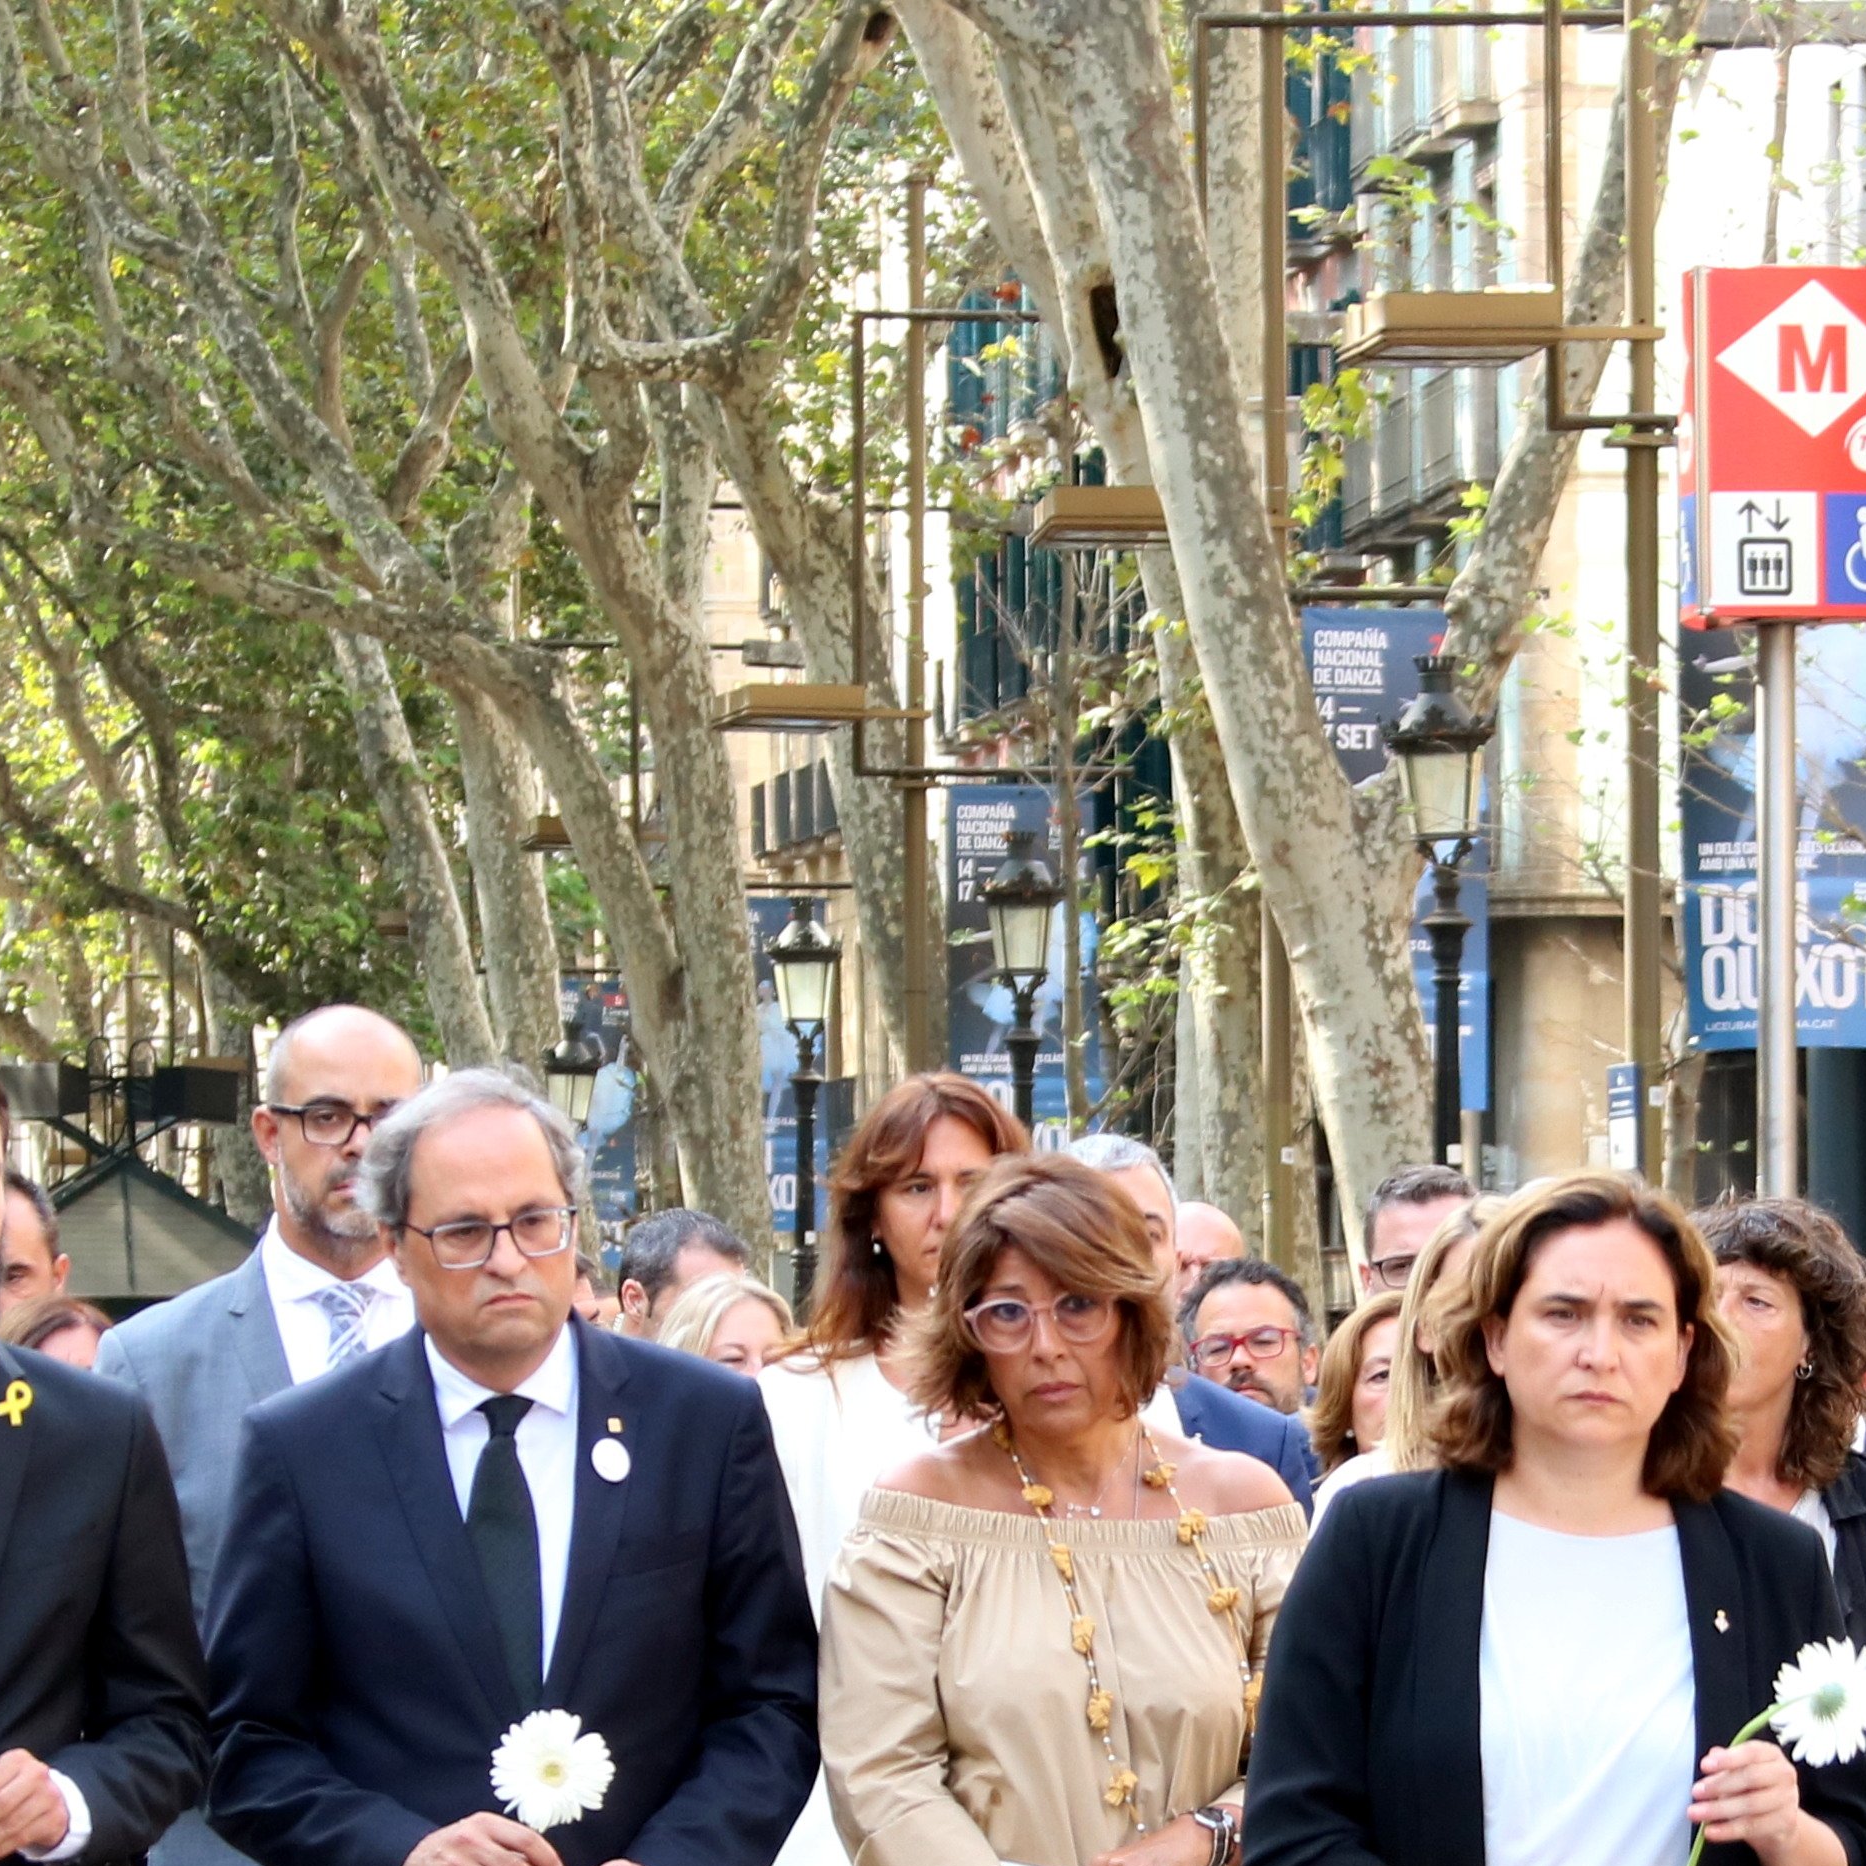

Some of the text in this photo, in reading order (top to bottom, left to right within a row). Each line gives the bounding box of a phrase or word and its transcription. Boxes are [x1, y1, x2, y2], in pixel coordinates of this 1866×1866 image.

[1778, 325, 1847, 393] M
[1314, 628, 1389, 649] COMPAÑÍA
[1313, 649, 1384, 667] NACIONAL
[1313, 667, 1383, 685] DE DANZA
[1336, 723, 1377, 749] SET
[956, 802, 1016, 820] COMPAÑÍA
[956, 834, 973, 850] DE
[957, 858, 975, 879] 14
[957, 880, 976, 902] 17
